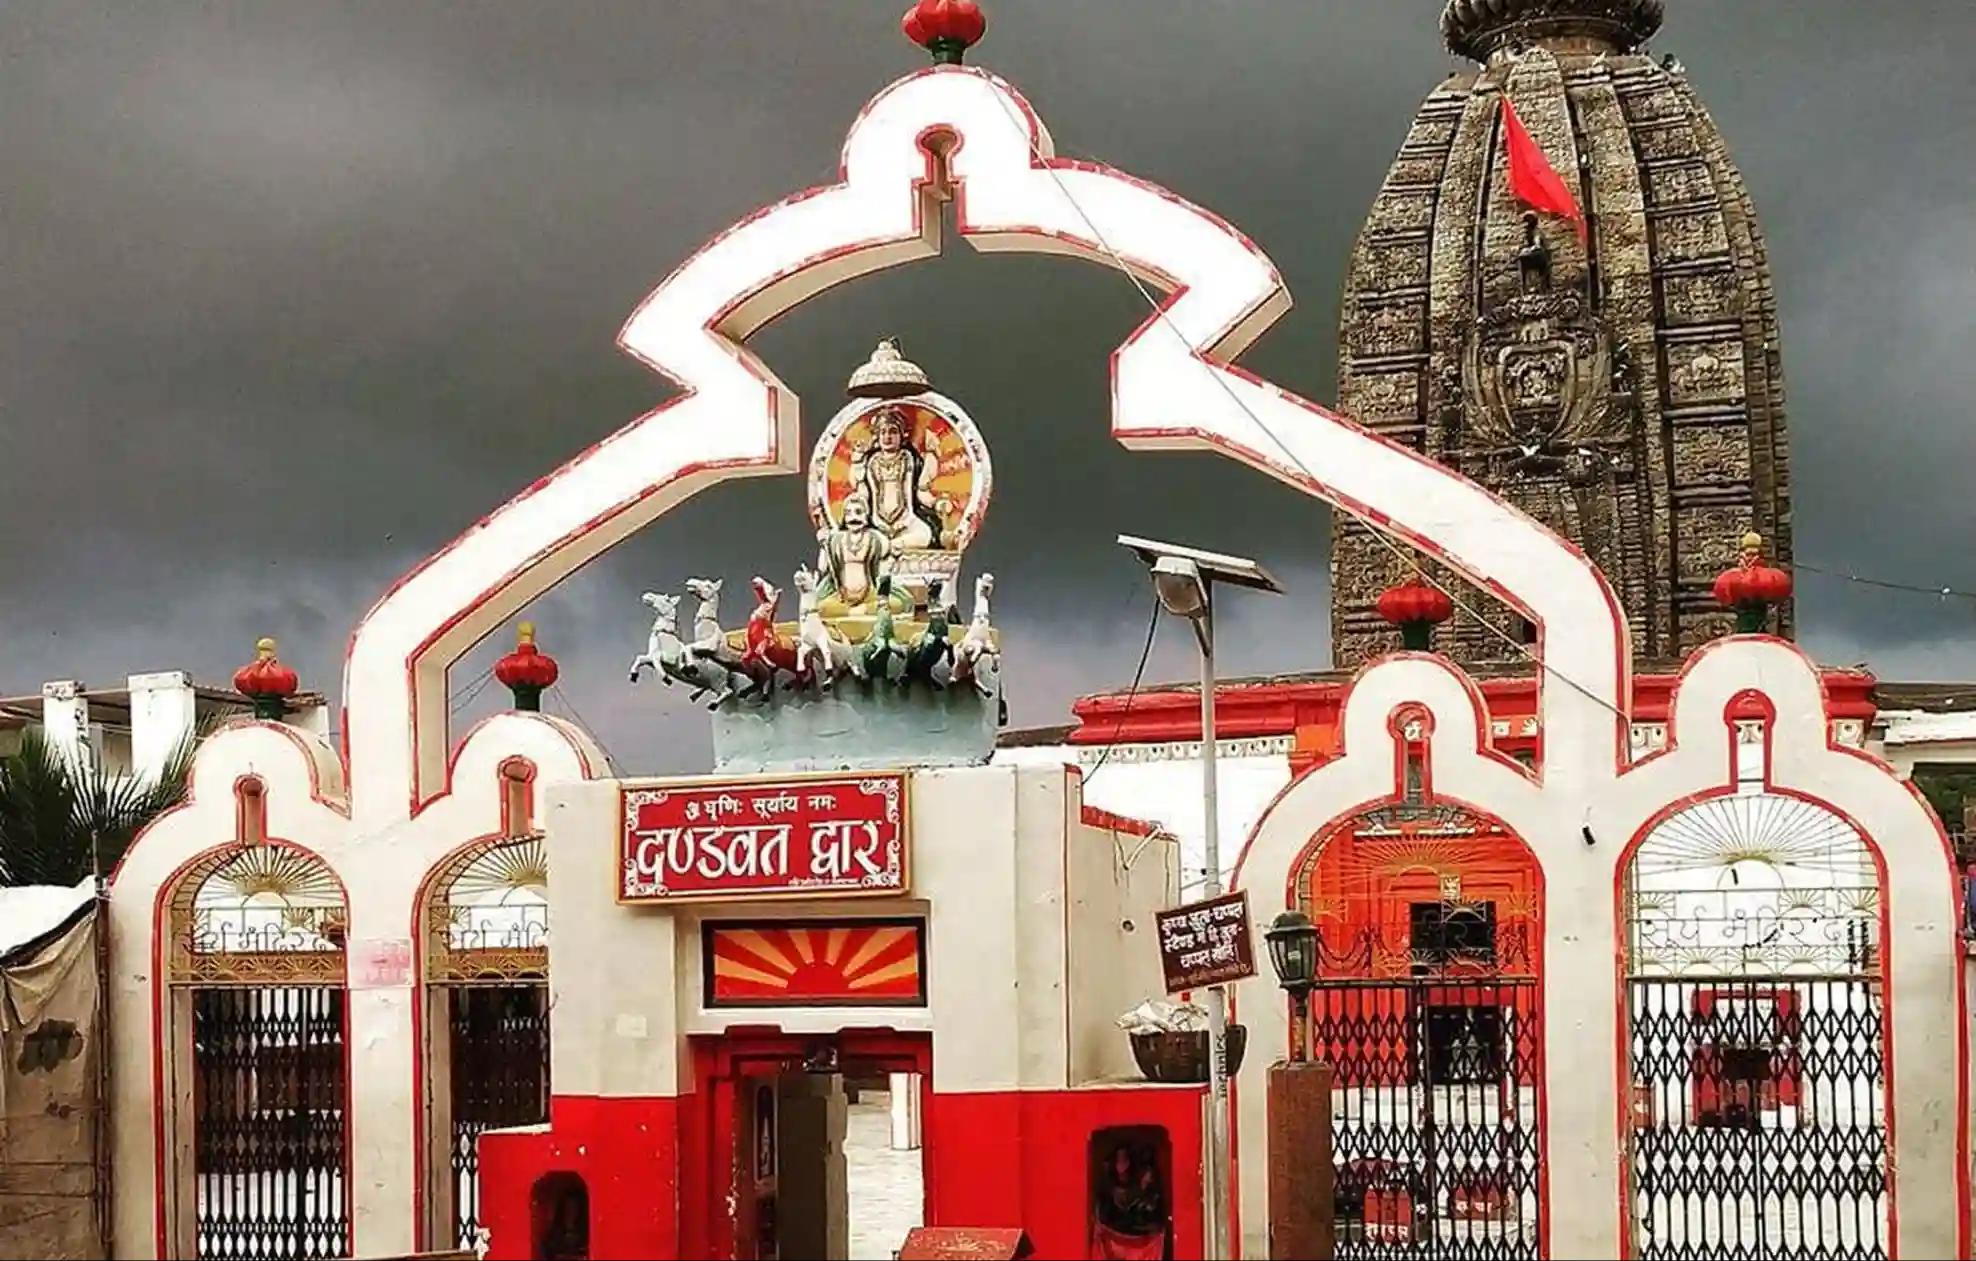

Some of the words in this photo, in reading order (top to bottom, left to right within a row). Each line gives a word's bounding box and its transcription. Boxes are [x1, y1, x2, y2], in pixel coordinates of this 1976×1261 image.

[752, 791, 799, 819] सूर्याय
[635, 823, 793, 883] दण्डवत
[809, 820, 882, 879] द्वार
